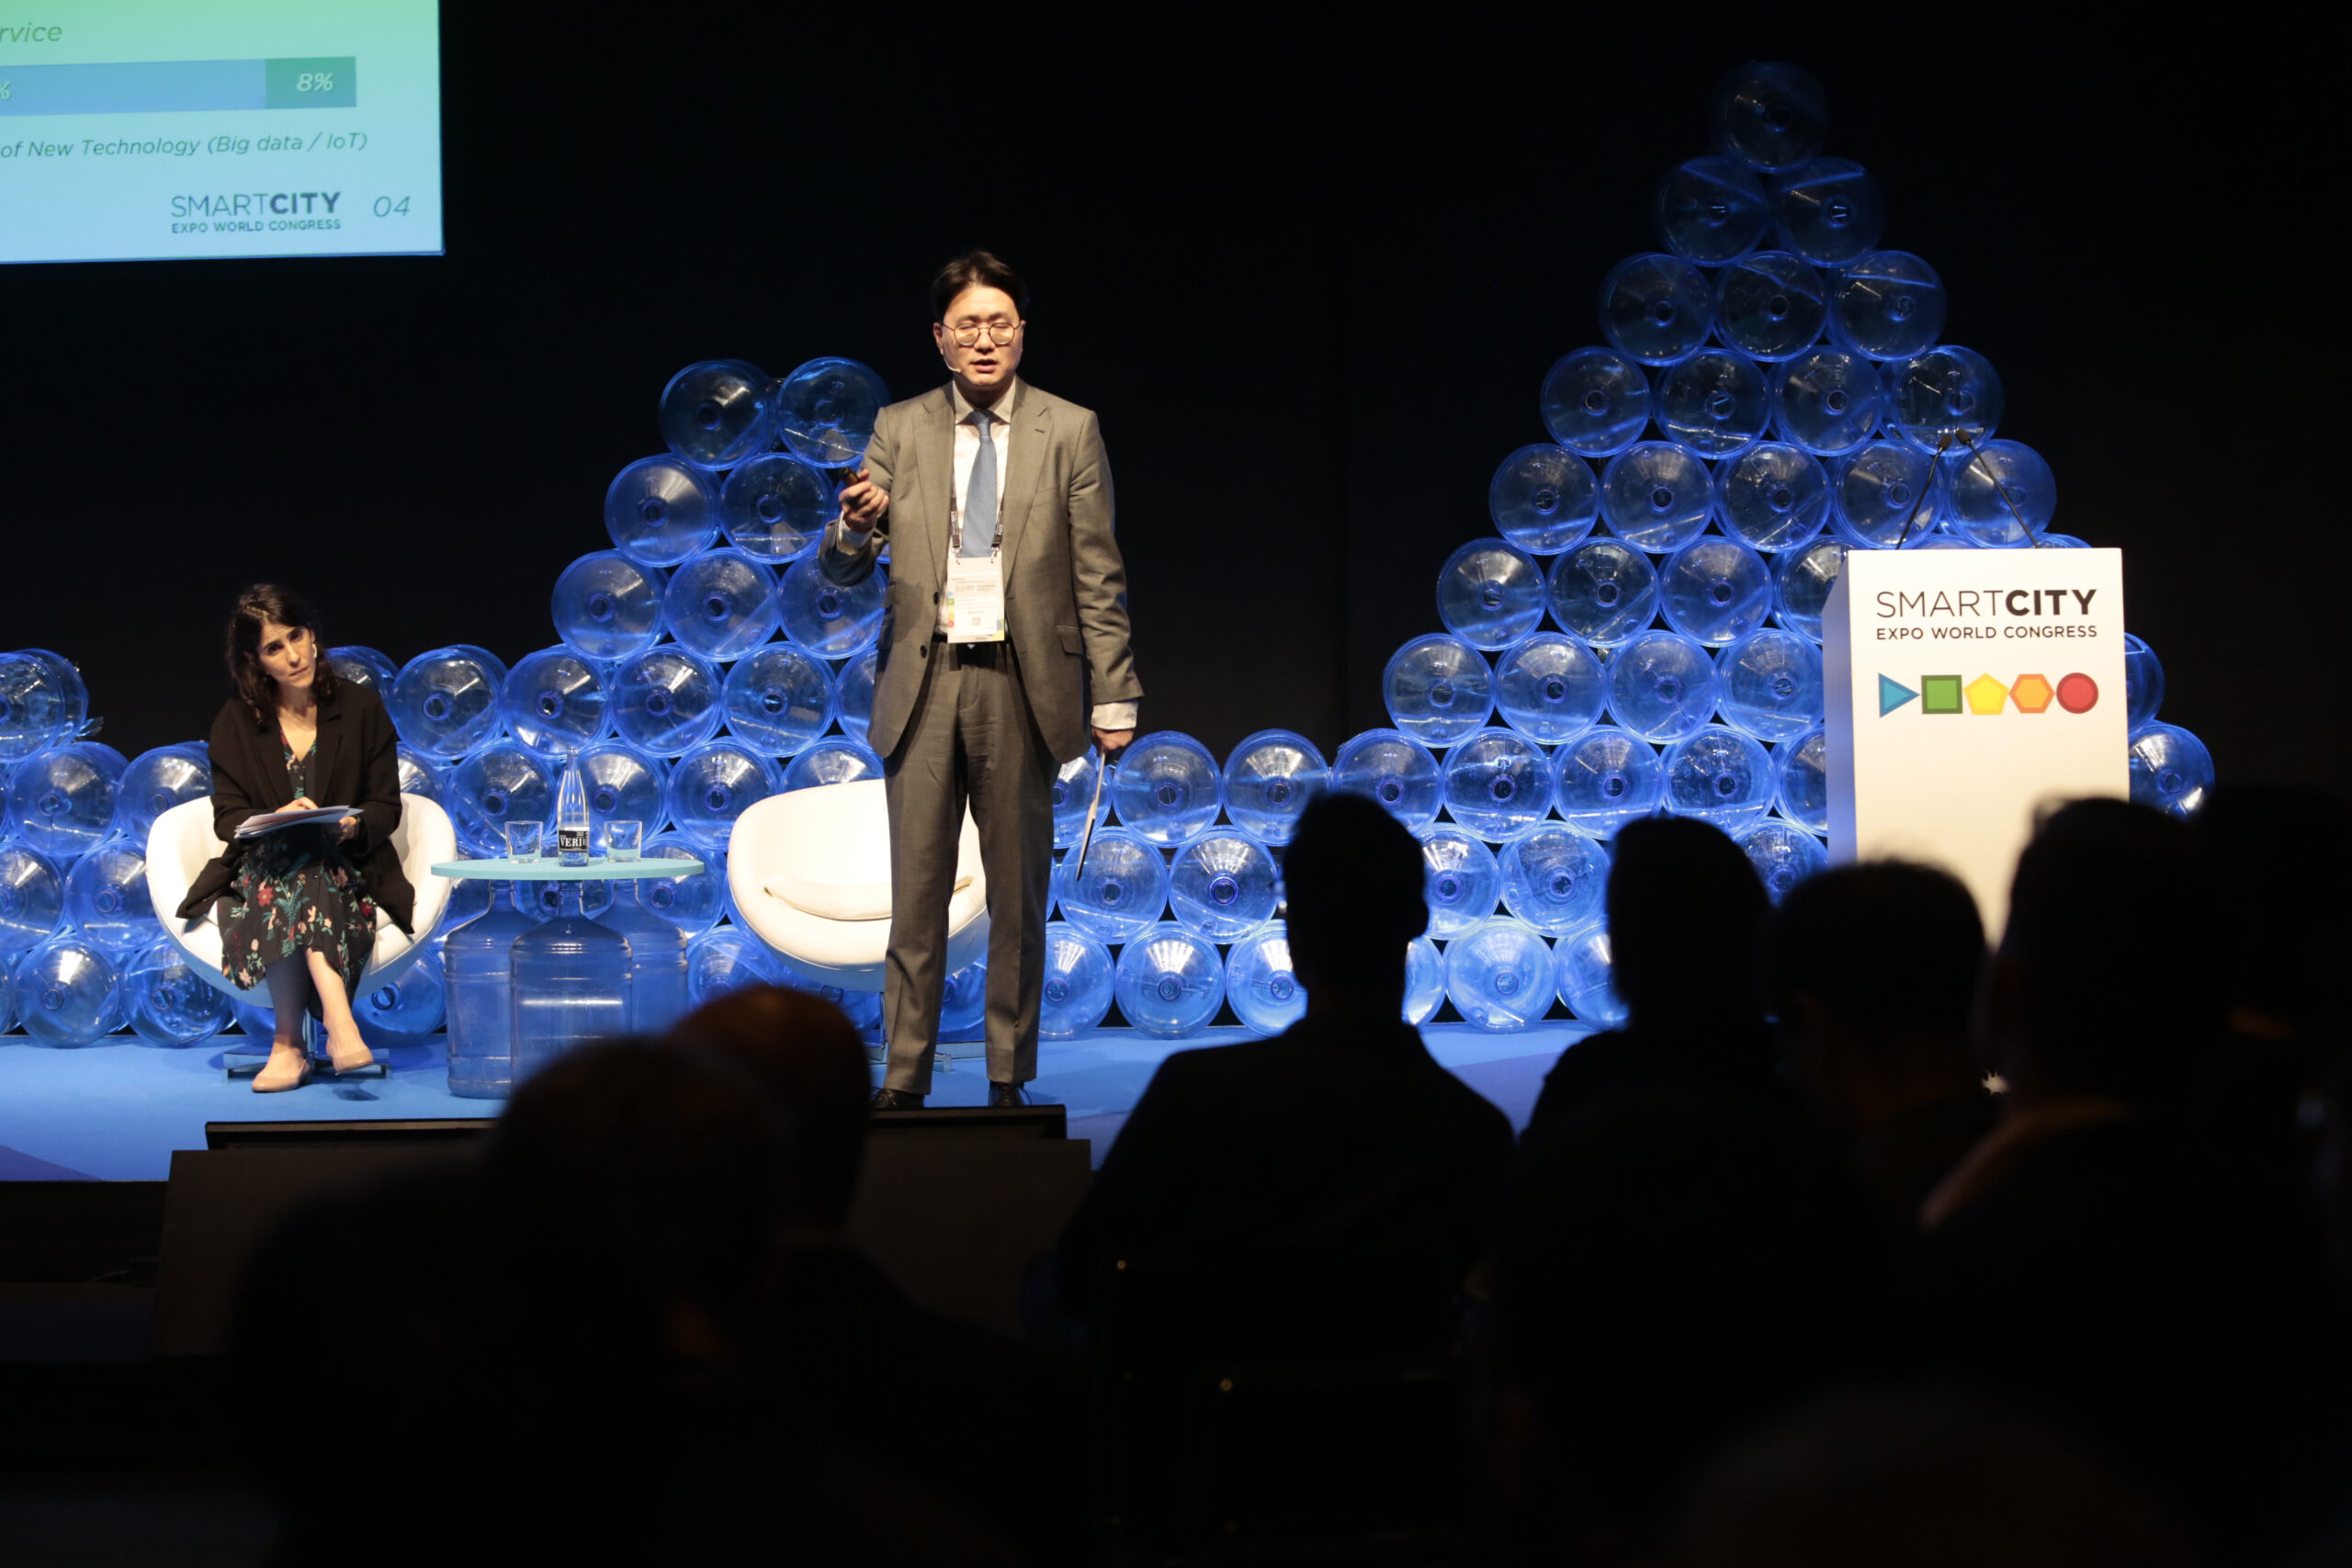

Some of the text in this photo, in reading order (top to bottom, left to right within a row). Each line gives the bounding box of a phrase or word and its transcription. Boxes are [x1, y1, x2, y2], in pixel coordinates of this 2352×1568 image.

[297, 73, 334, 92] 8%
[0, 141, 24, 158] of
[28, 140, 74, 157] New
[82, 138, 200, 156] Technology
[208, 135, 250, 154] (Big
[257, 133, 302, 152] data
[307, 132, 322, 152] /
[171, 191, 341, 218] SMARTCITY
[373, 196, 411, 218] 04
[172, 219, 341, 233] EXPO WORLD CONGRESS
[1876, 589, 2098, 617] SMARTCITY
[1876, 626, 2098, 640] EXPO WORLD CONGRESS
